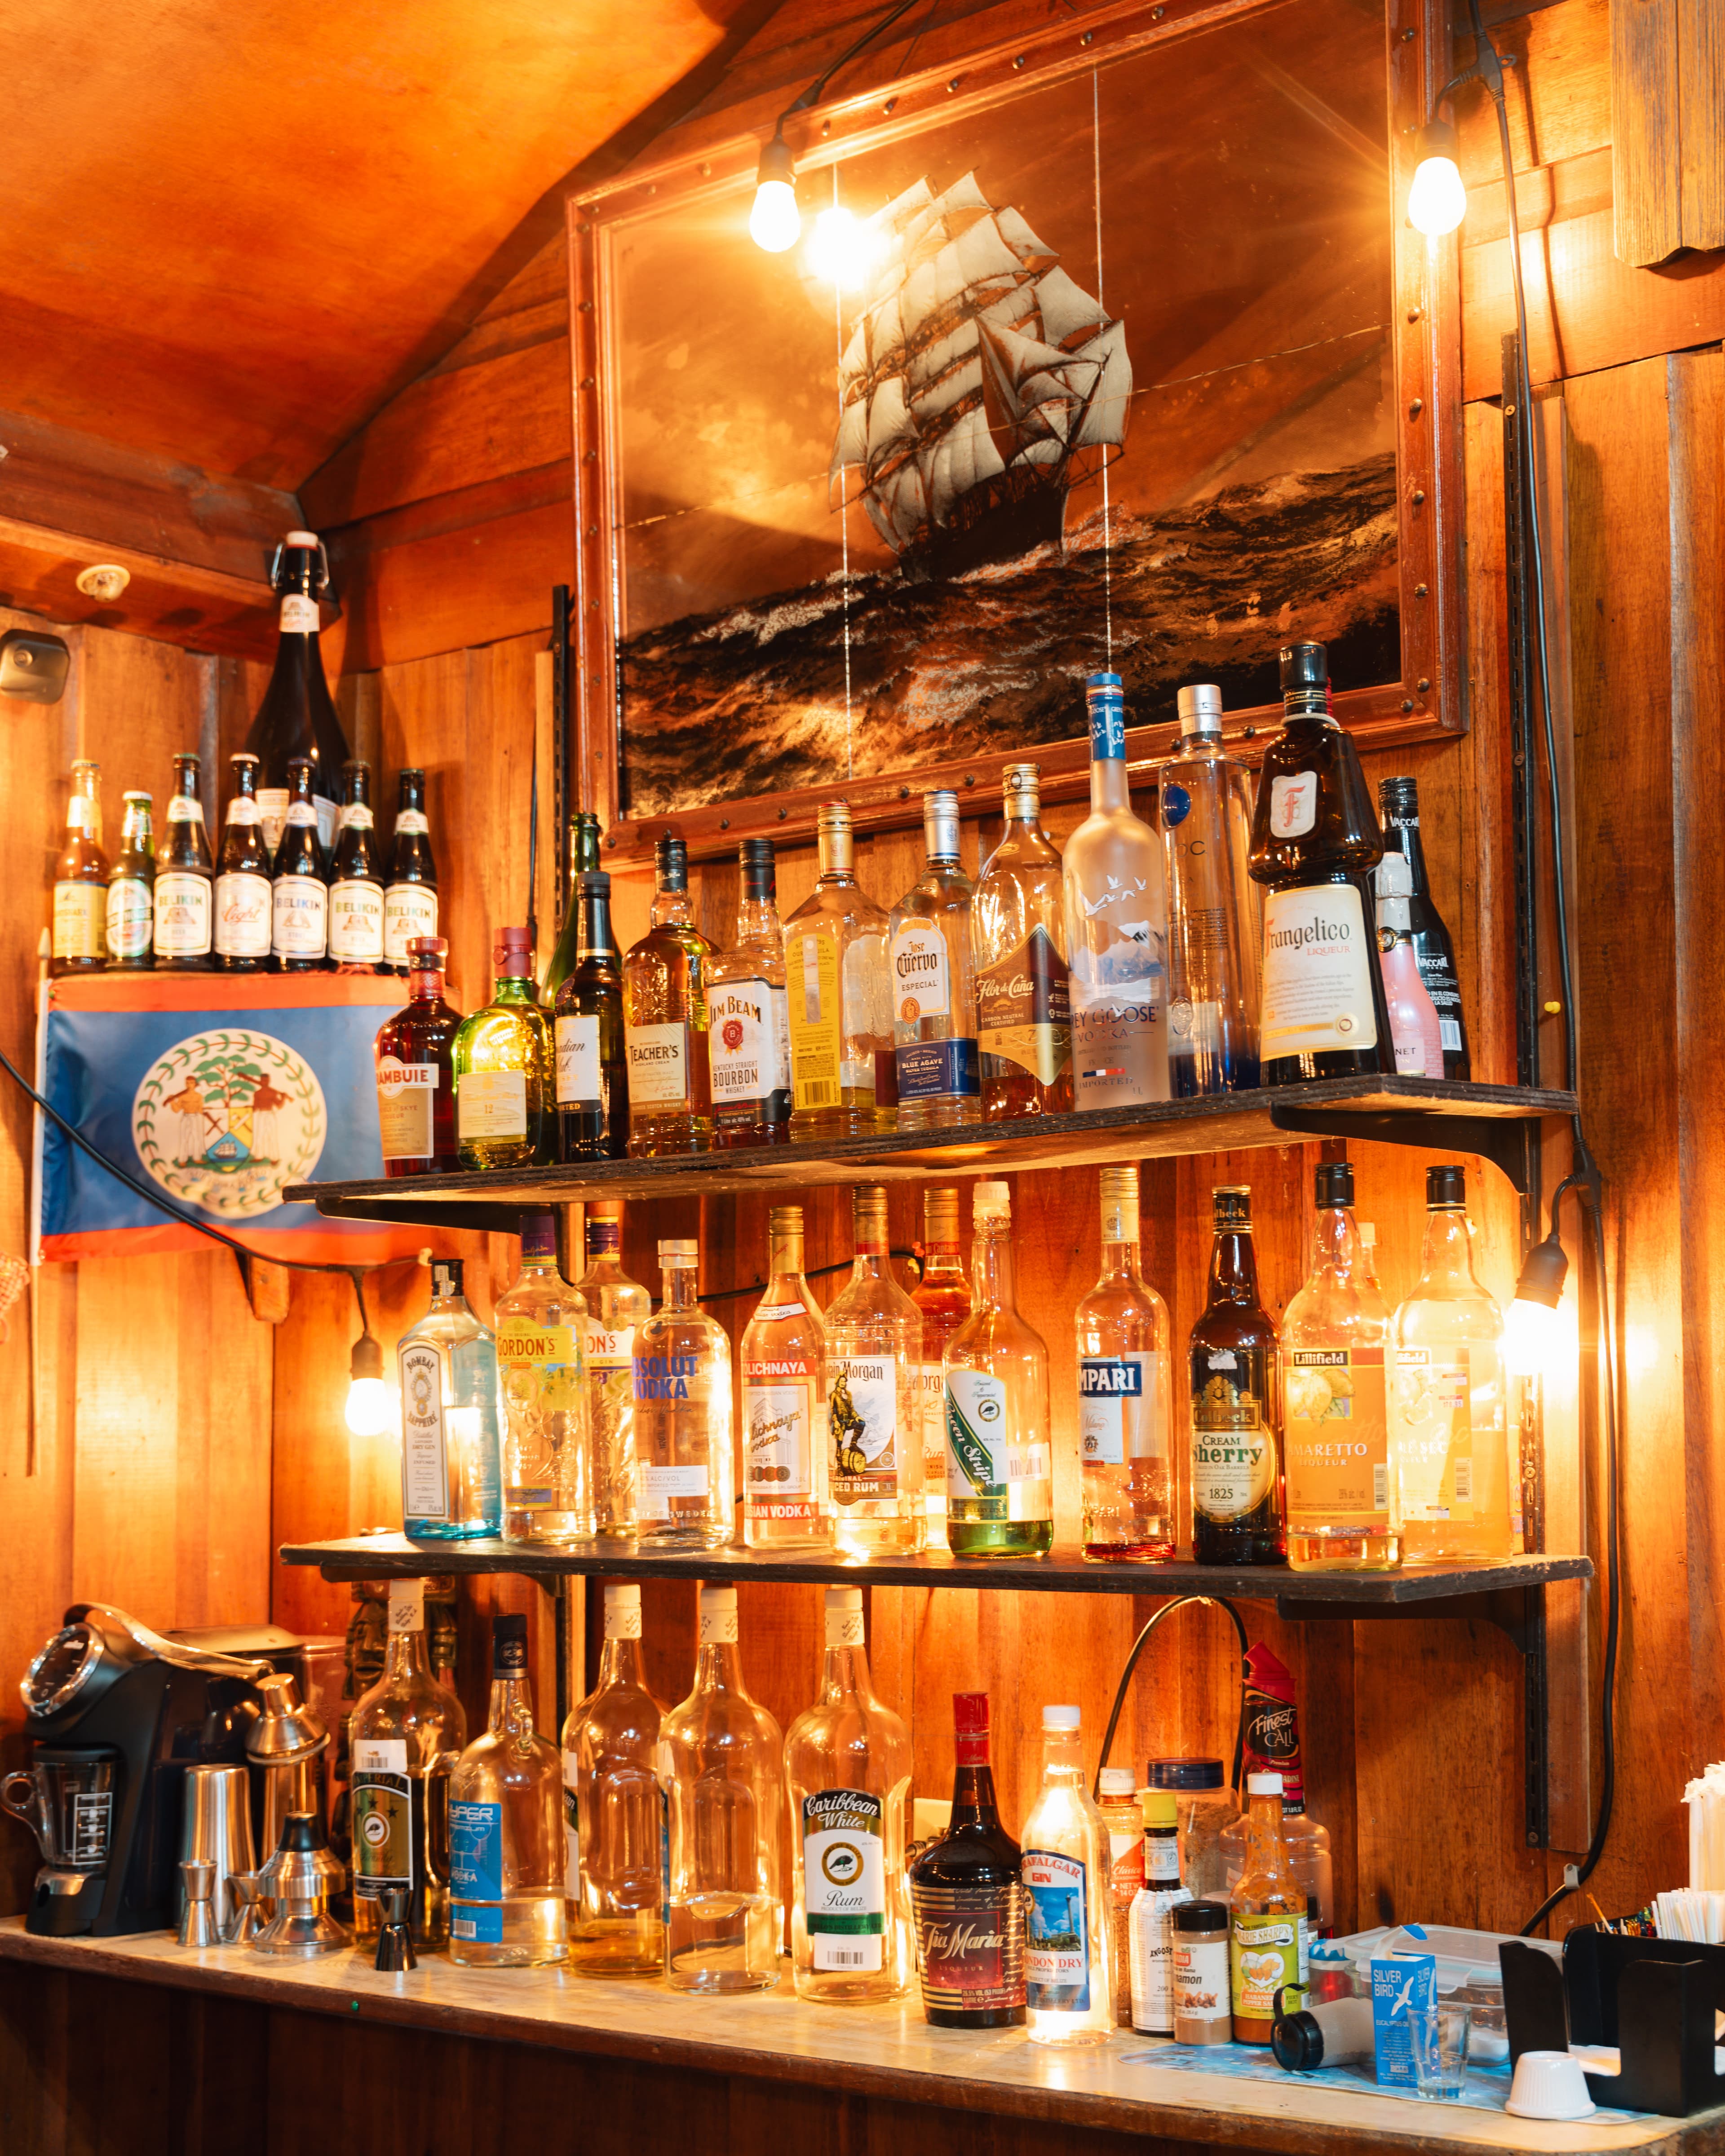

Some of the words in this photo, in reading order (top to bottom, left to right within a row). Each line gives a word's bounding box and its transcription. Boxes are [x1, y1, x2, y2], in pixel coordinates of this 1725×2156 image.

[159, 895, 202, 906] BELIKIN
[277, 898, 321, 911] BELIKIN
[336, 902, 380, 915] BELIKIN
[387, 906, 431, 919] BELIKIN
[1265, 916, 1350, 958] Frangelico
[1307, 945, 1351, 956] LIQUEUR
[897, 951, 938, 978] Cuervo
[902, 980, 937, 991] ESPECIAL
[976, 979, 1000, 1004] Flor
[1008, 974, 1035, 998] Caña
[727, 996, 762, 1025] BEAM
[1092, 1006, 1157, 1025] GOOSE
[1078, 1028, 1128, 1043] VODKA
[629, 1044, 679, 1065] TEACHER'S
[1395, 1047, 1416, 1056] NET
[712, 1062, 734, 1072] KENTUCKY
[735, 1060, 758, 1070] STRAIGHT
[920, 1058, 943, 1066] AGAVE
[713, 1068, 758, 1087] BOURBON
[1079, 1078, 1133, 1089] IMPORTED
[725, 1085, 745, 1094] WHISKEY
[484, 1103, 493, 1114] 12
[497, 1336, 556, 1356] GORDON'S
[1295, 1352, 1344, 1365] Lillifield
[632, 1356, 698, 1378] BSOLUT
[841, 1361, 884, 1382] Morgan
[1079, 1367, 1135, 1391] MPARI
[632, 1378, 689, 1400] VODKA
[1194, 1409, 1252, 1423] Colbeck
[1202, 1435, 1241, 1446] CREAM
[1289, 1443, 1368, 1457] AMARETTO
[964, 1445, 998, 1488] Stripe
[853, 1481, 879, 1493] RUM
[1209, 1488, 1234, 1499] 1825
[770, 1504, 812, 1517] VODKA
[1256, 1707, 1297, 1735] Finest
[1265, 1729, 1294, 1747] CALL
[1283, 1774, 1300, 1782] ADINE
[806, 1793, 878, 1816] Caribbean
[817, 1811, 865, 1829] White
[1031, 1872, 1052, 1883] GIN
[1113, 1865, 1141, 1876] Clásico
[823, 1890, 865, 1907] Rum
[922, 1921, 951, 1957] Tia
[938, 1923, 1004, 1960] Maria
[1258, 1926, 1290, 1943] SHARP'S
[1058, 1957, 1084, 1968] DRY
[1374, 1969, 1402, 1983] SILVER
[1374, 1984, 1394, 1997] BIRD
